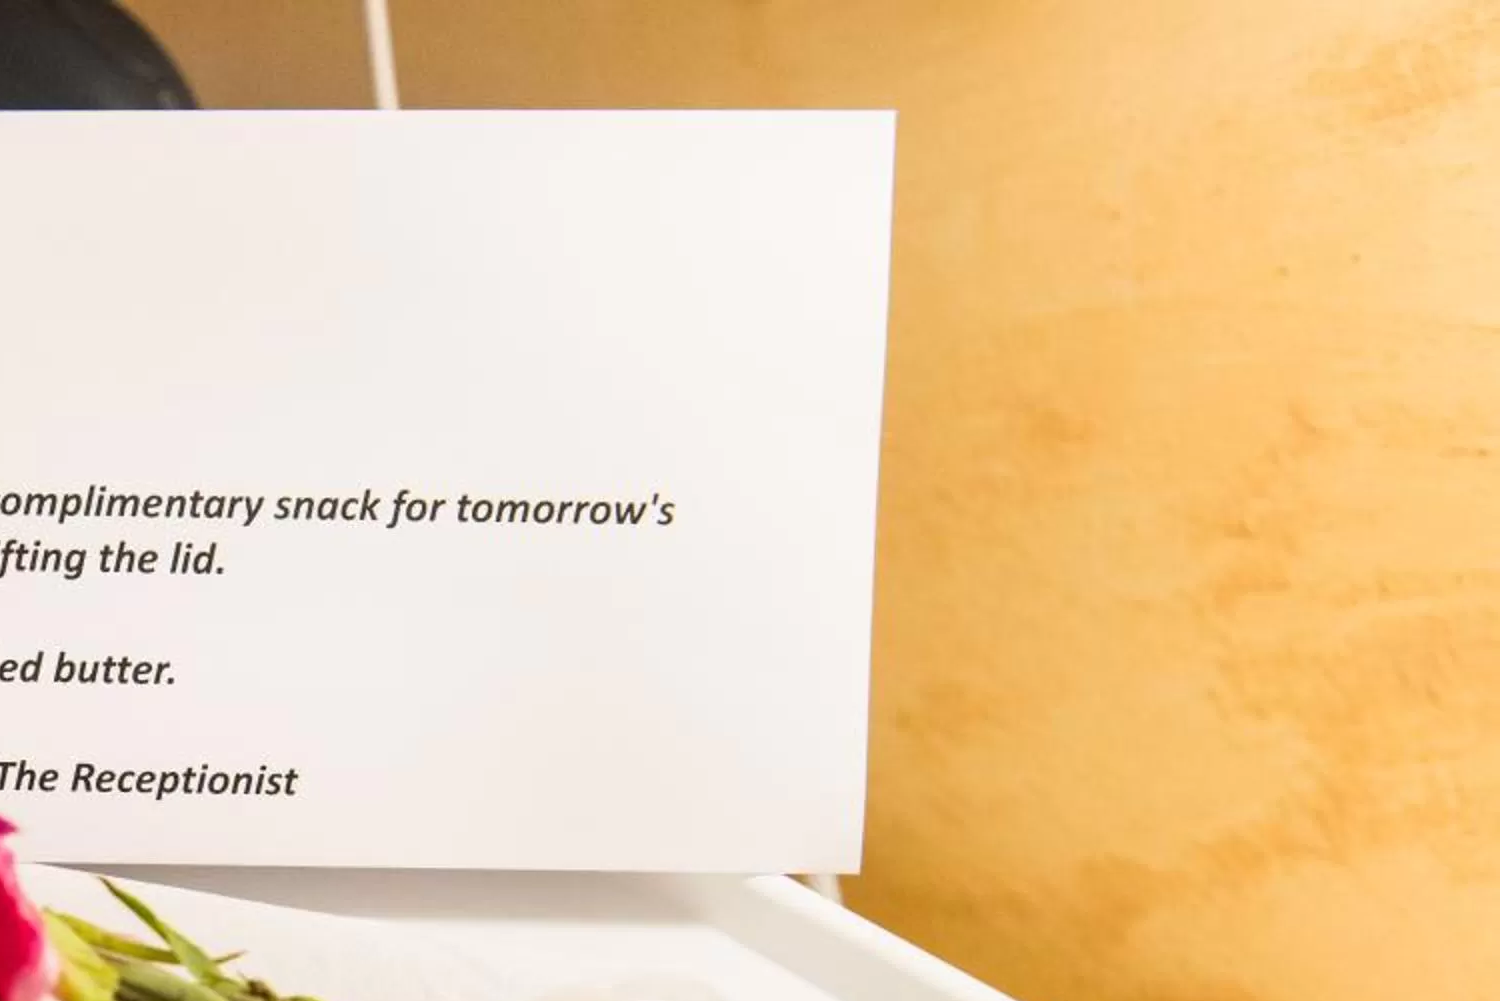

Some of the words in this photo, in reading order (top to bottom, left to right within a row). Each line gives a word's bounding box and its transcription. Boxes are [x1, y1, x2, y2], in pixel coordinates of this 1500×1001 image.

[274, 489, 381, 521] snack
[387, 489, 446, 529] for
[457, 493, 675, 526] tomorrow's
[99, 541, 159, 574] the
[170, 541, 225, 575] lid.
[53, 651, 175, 685] butter.
[71, 763, 299, 801] Receptionist
